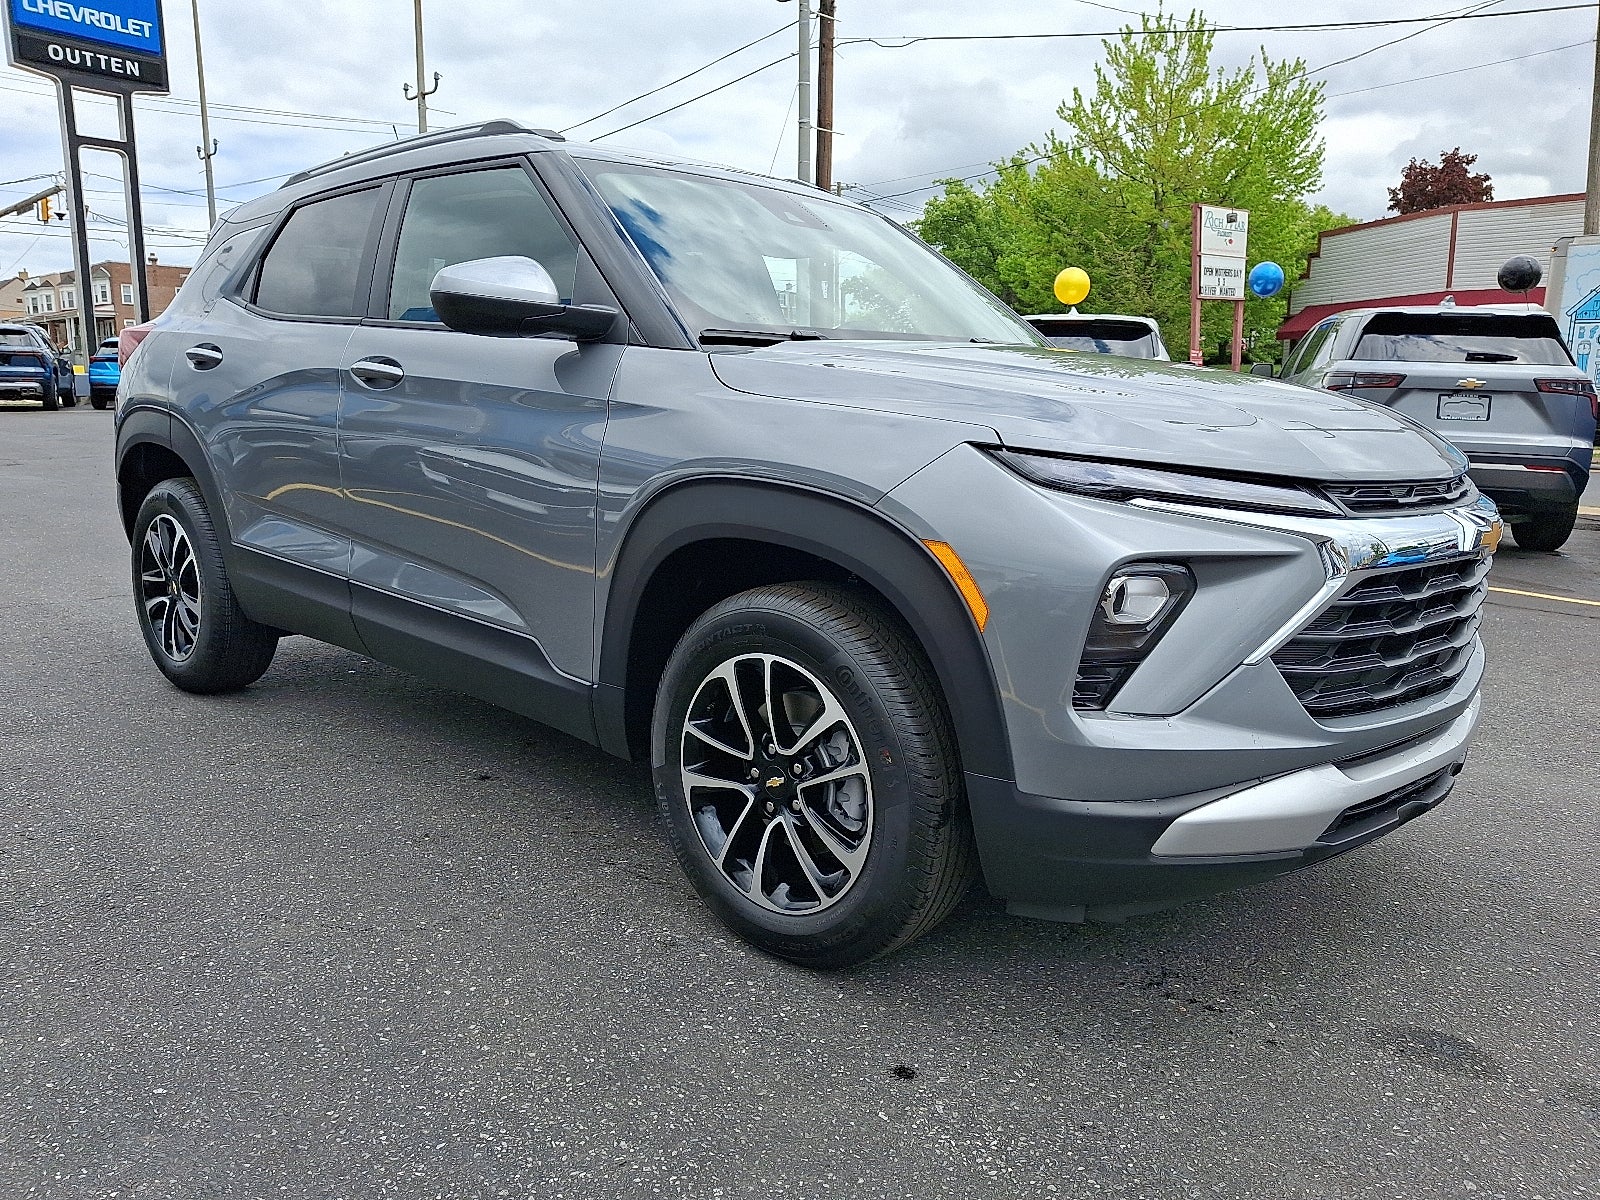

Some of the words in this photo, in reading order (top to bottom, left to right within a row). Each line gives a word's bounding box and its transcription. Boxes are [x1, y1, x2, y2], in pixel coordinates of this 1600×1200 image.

[22, 0, 153, 38] CHEVROLET
[47, 44, 141, 77] OUTTEN
[1204, 267, 1213, 276] OPEN
[1215, 268, 1233, 277] MOTHERS
[1233, 270, 1242, 278] DAY
